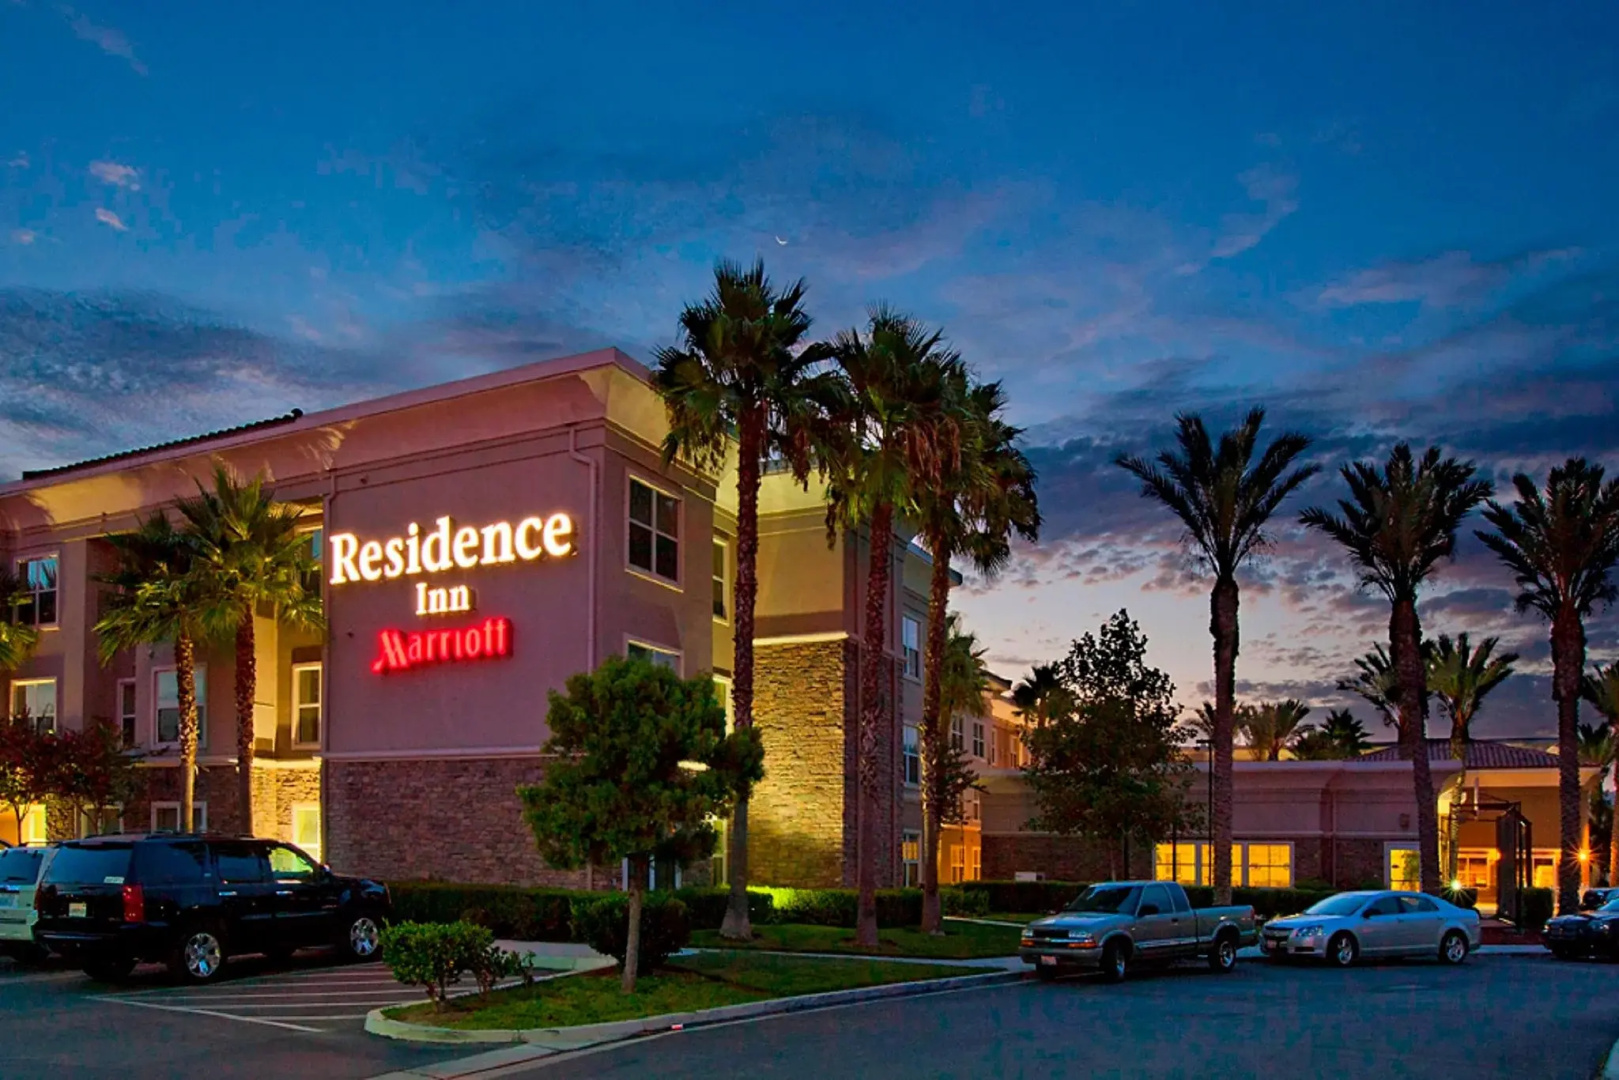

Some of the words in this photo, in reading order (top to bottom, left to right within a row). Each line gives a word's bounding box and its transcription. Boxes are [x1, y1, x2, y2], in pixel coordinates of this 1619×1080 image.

[329, 512, 572, 585] Residence
[415, 582, 471, 615] Inn
[371, 617, 510, 673] Marriott
